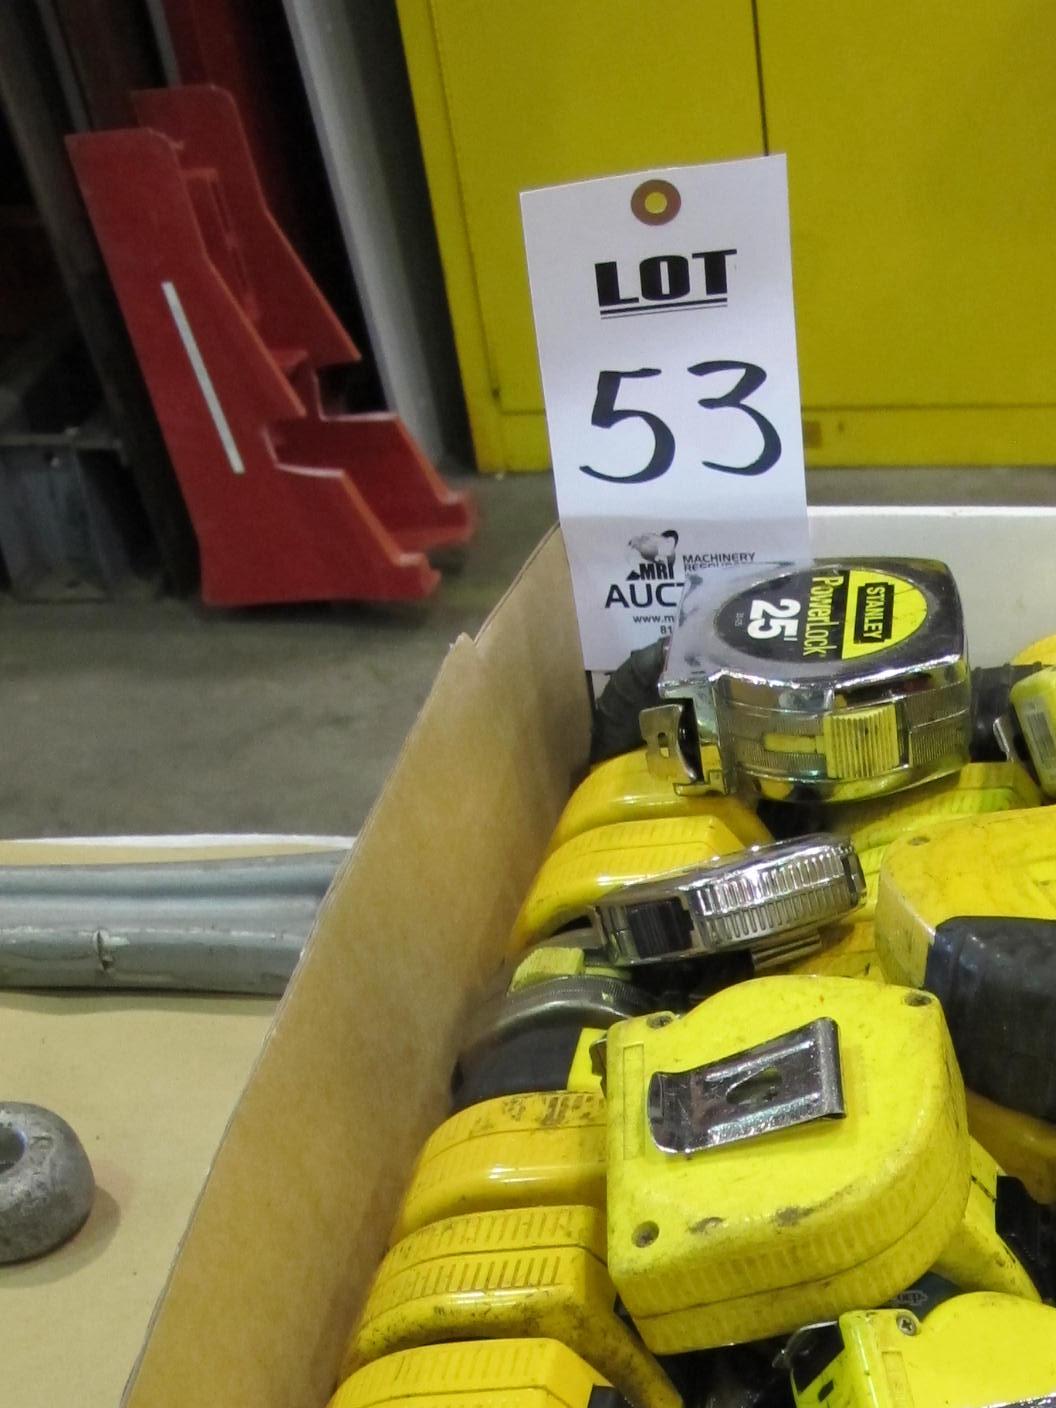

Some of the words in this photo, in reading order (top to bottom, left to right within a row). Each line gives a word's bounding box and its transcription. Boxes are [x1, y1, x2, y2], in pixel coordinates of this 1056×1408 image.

[594, 249, 737, 307] LOT
[579, 360, 782, 484] 53
[639, 560, 675, 581] MRI
[683, 552, 756, 564] MACHINERY
[803, 576, 844, 657] PowerLock
[863, 585, 886, 640] STANLEY
